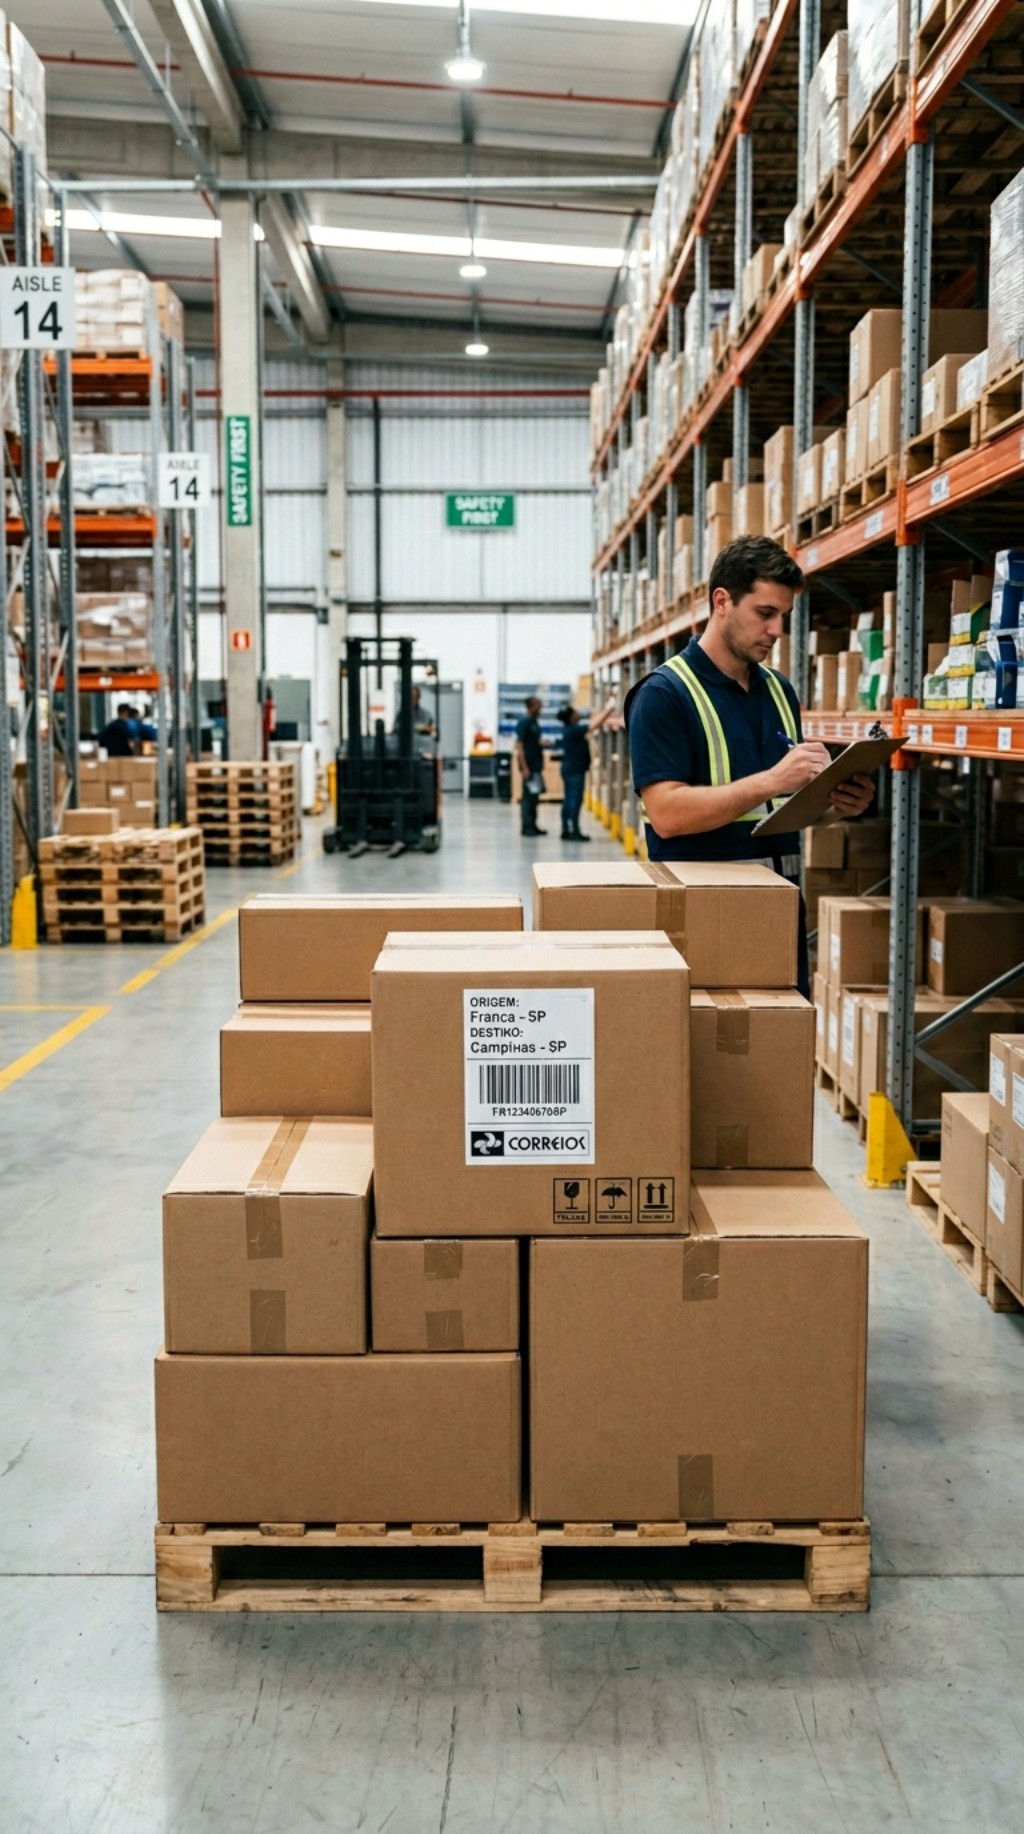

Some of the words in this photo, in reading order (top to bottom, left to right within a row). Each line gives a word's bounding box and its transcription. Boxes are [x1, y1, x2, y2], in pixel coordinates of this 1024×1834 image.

[12, 275, 62, 292] AISLE
[14, 300, 63, 341] 14
[169, 476, 200, 501] 14
[231, 464, 249, 524] SAFETY
[470, 996, 520, 1008] ORIGEM:
[470, 1010, 515, 1023] Franca
[528, 1010, 547, 1023] SP
[548, 1040, 567, 1053] SP
